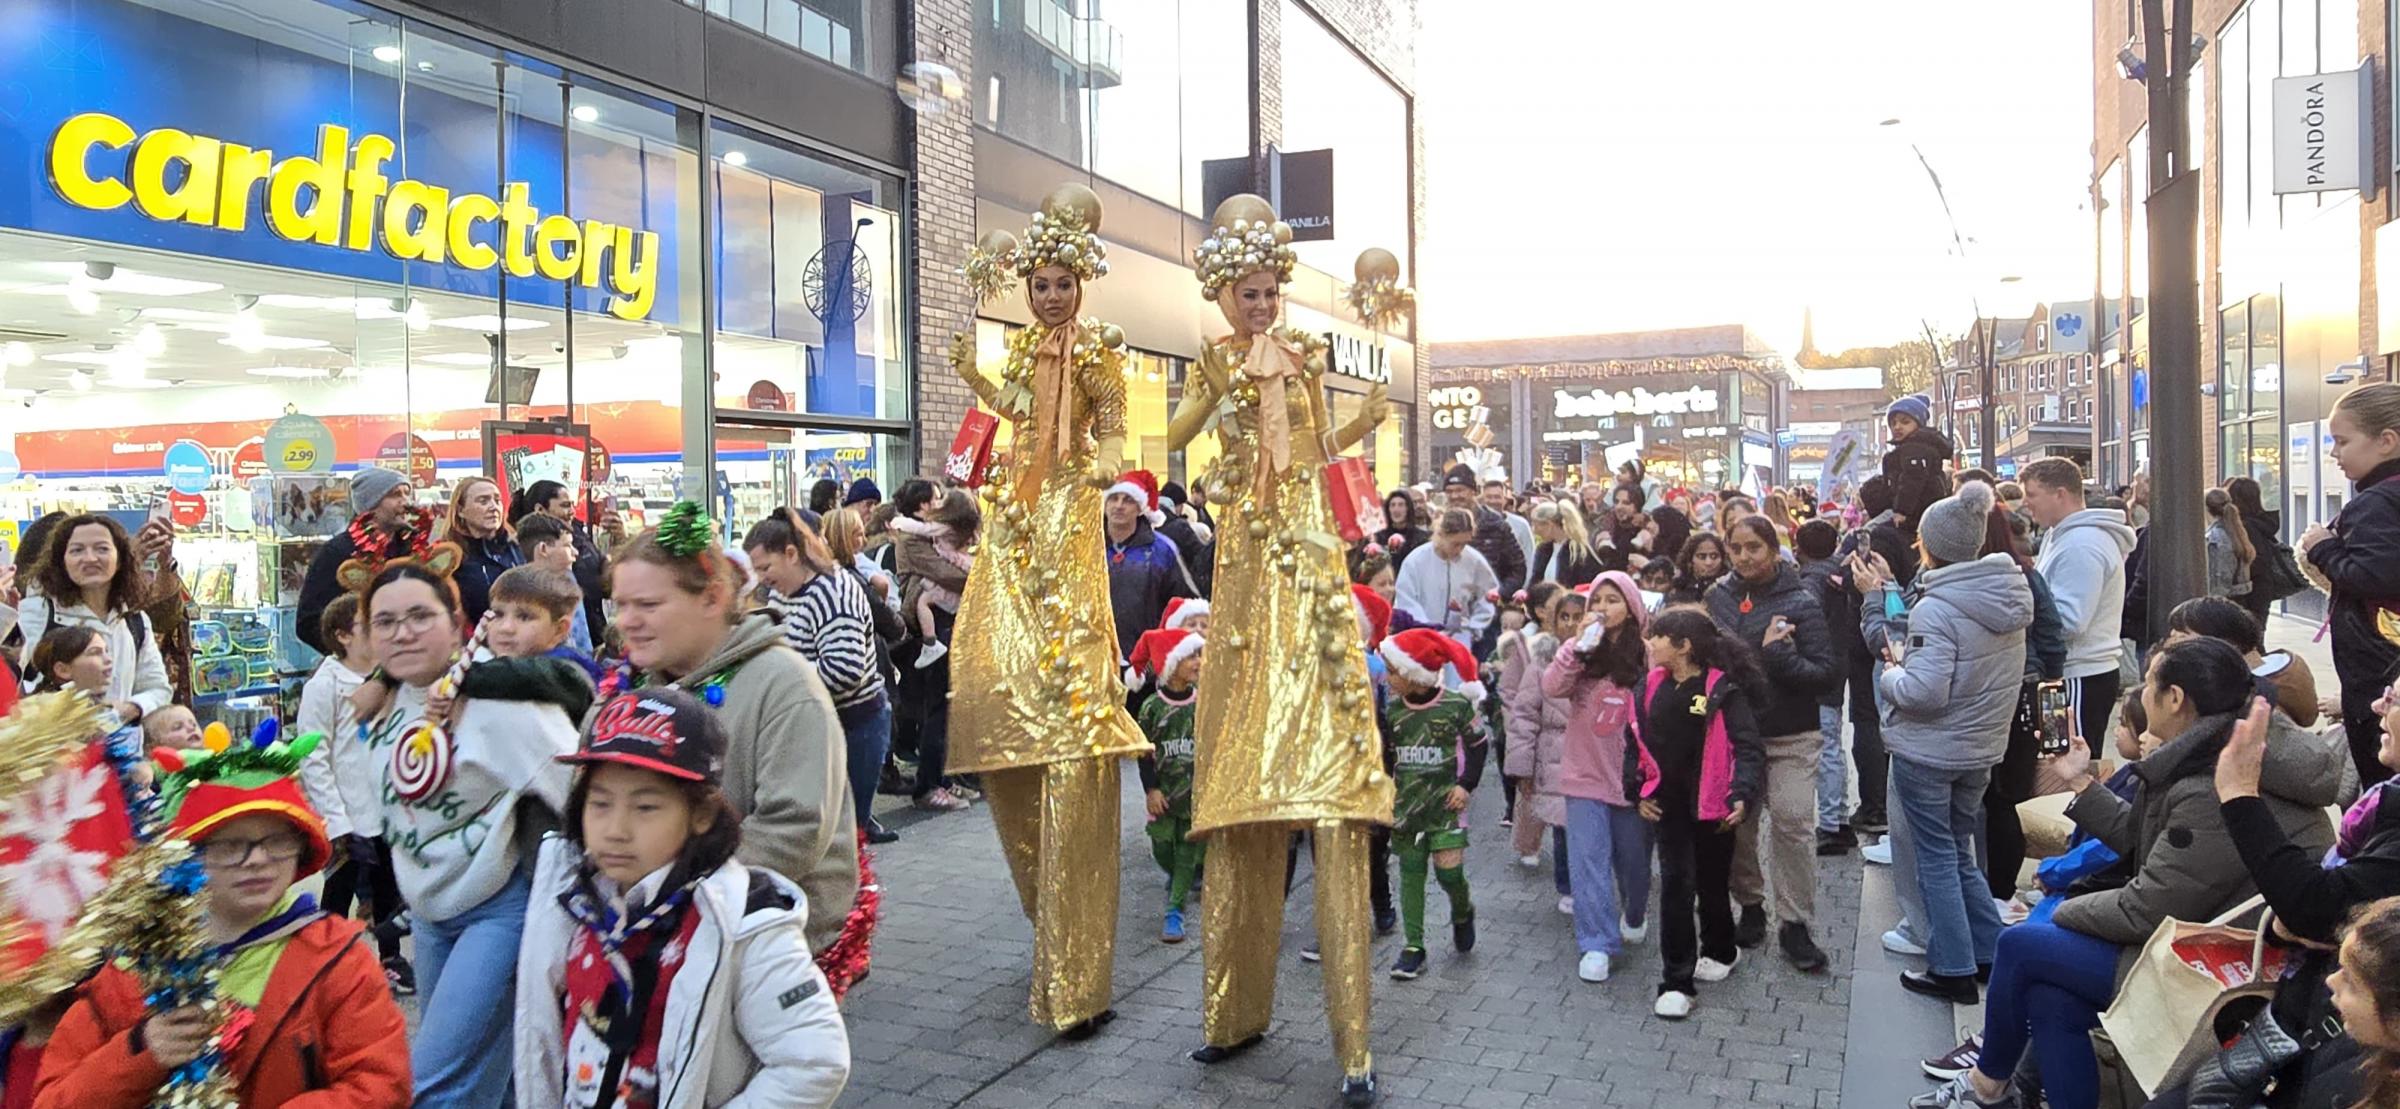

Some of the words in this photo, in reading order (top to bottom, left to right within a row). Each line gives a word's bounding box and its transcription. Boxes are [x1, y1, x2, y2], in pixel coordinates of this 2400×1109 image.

[2305, 82, 2325, 185] PANDORA
[46, 112, 660, 321] cardfactory
[1284, 215, 1331, 228] VANILLA
[1428, 386, 1481, 407] NTO
